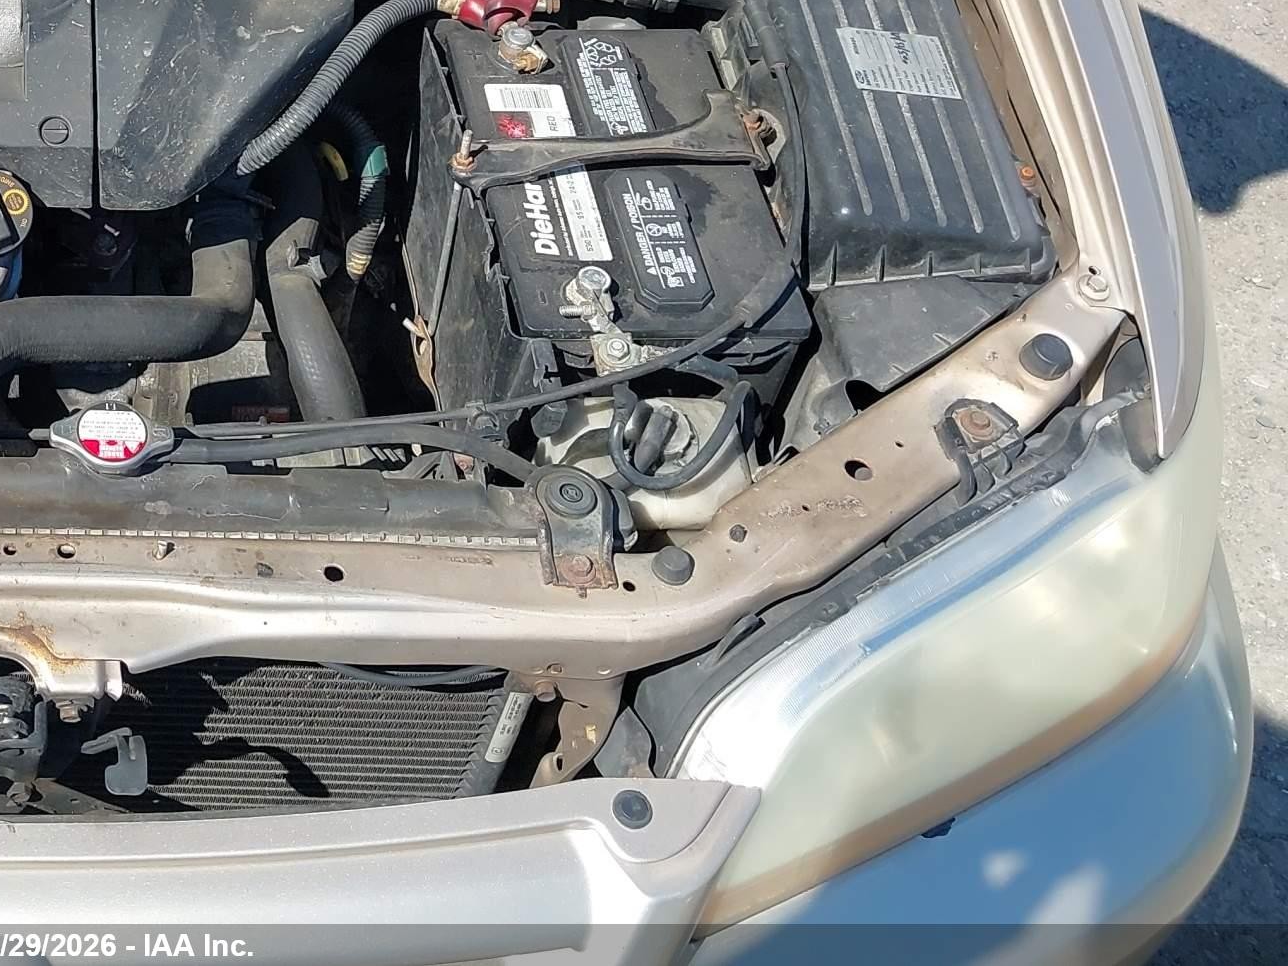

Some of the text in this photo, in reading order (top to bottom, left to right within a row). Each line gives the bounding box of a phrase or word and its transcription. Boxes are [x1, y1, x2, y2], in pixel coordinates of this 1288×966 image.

[547, 115, 559, 131] RED
[523, 182, 561, 256] DieHar
[621, 192, 640, 224] POISON
[634, 230, 654, 266] DANGER
